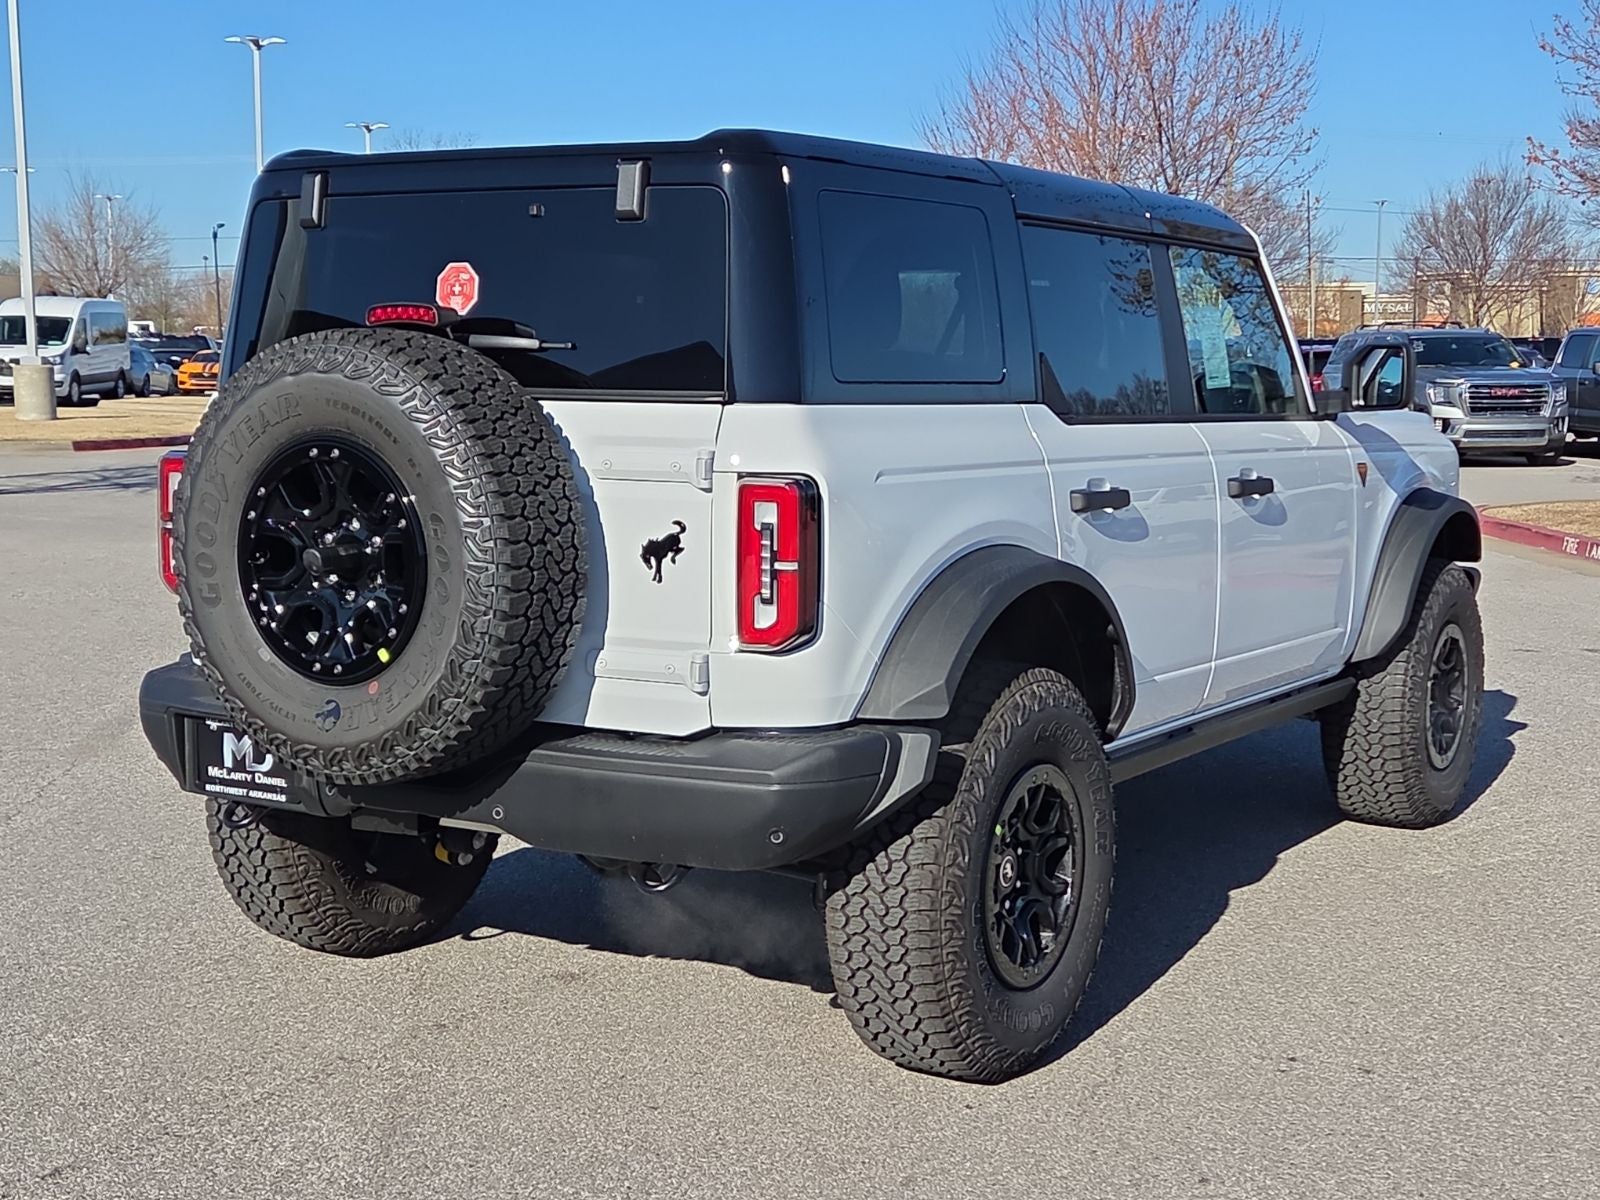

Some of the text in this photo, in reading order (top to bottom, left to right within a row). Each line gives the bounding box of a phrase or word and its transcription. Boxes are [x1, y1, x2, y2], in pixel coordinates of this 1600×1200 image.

[1364, 303, 1385, 313] MY
[1562, 536, 1580, 555] FIRE
[254, 773, 288, 788] DANIEL
[205, 783, 287, 803] NORTHWEST ARKANSAS
